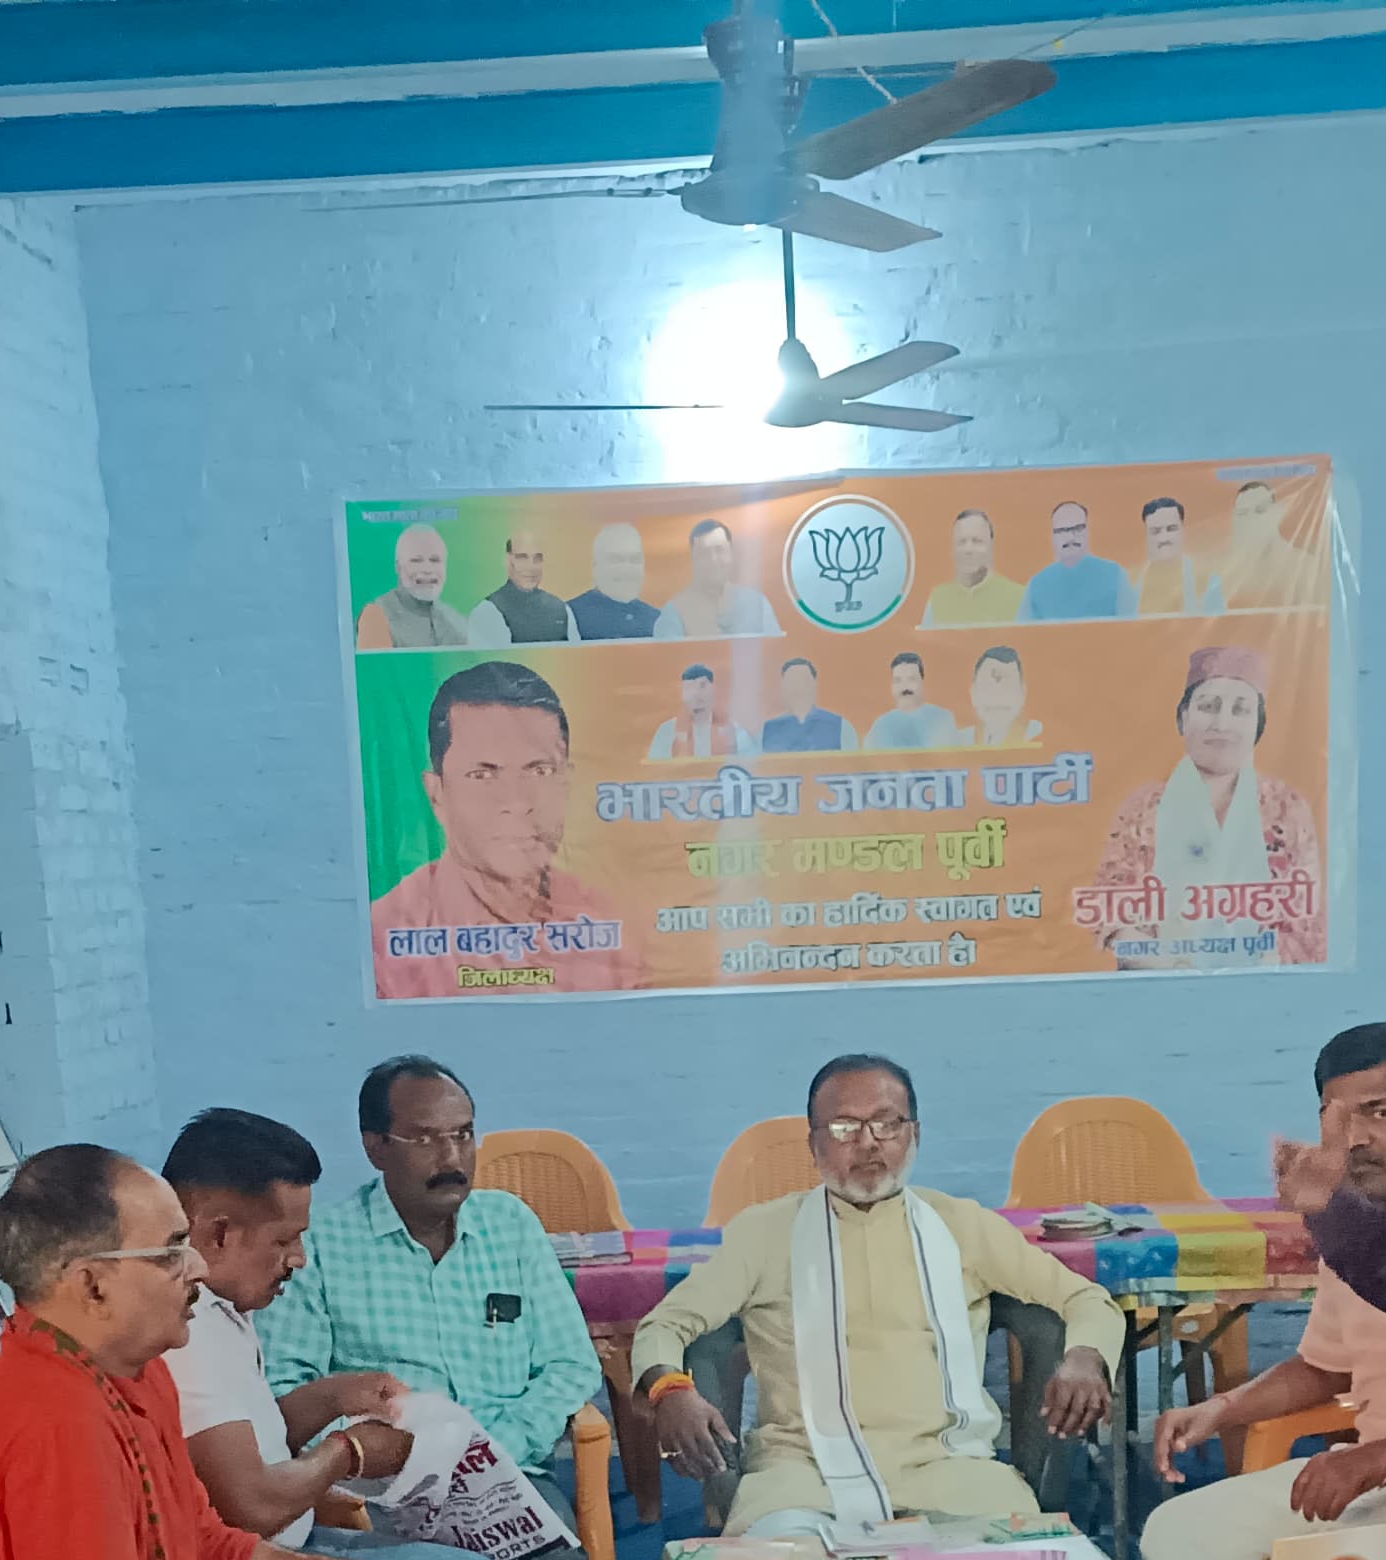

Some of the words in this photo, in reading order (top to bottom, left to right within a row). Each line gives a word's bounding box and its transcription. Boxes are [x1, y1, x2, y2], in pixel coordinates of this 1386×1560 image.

[595, 764, 803, 822] भारतीय
[814, 768, 969, 814] जनता
[980, 751, 1094, 807] पार्टी
[792, 833, 925, 873] मण्डल
[935, 816, 1007, 881] पूर्वी
[655, 905, 710, 933] आप
[716, 897, 773, 930] सभी
[780, 901, 817, 928] का
[822, 891, 908, 928] हार्दिक
[914, 894, 999, 924] स्वागत
[1003, 886, 1043, 920] एवं
[1073, 873, 1168, 926] डाली
[388, 928, 448, 957] लाल
[456, 922, 541, 961] बहादुर
[545, 914, 621, 952] सरोज
[720, 939, 862, 975] अभिनन्दन
[866, 940, 944, 968] करता
[456, 964, 556, 989] जिलाध्यक्ष
[451, 1505, 544, 1552] Jaiswal
